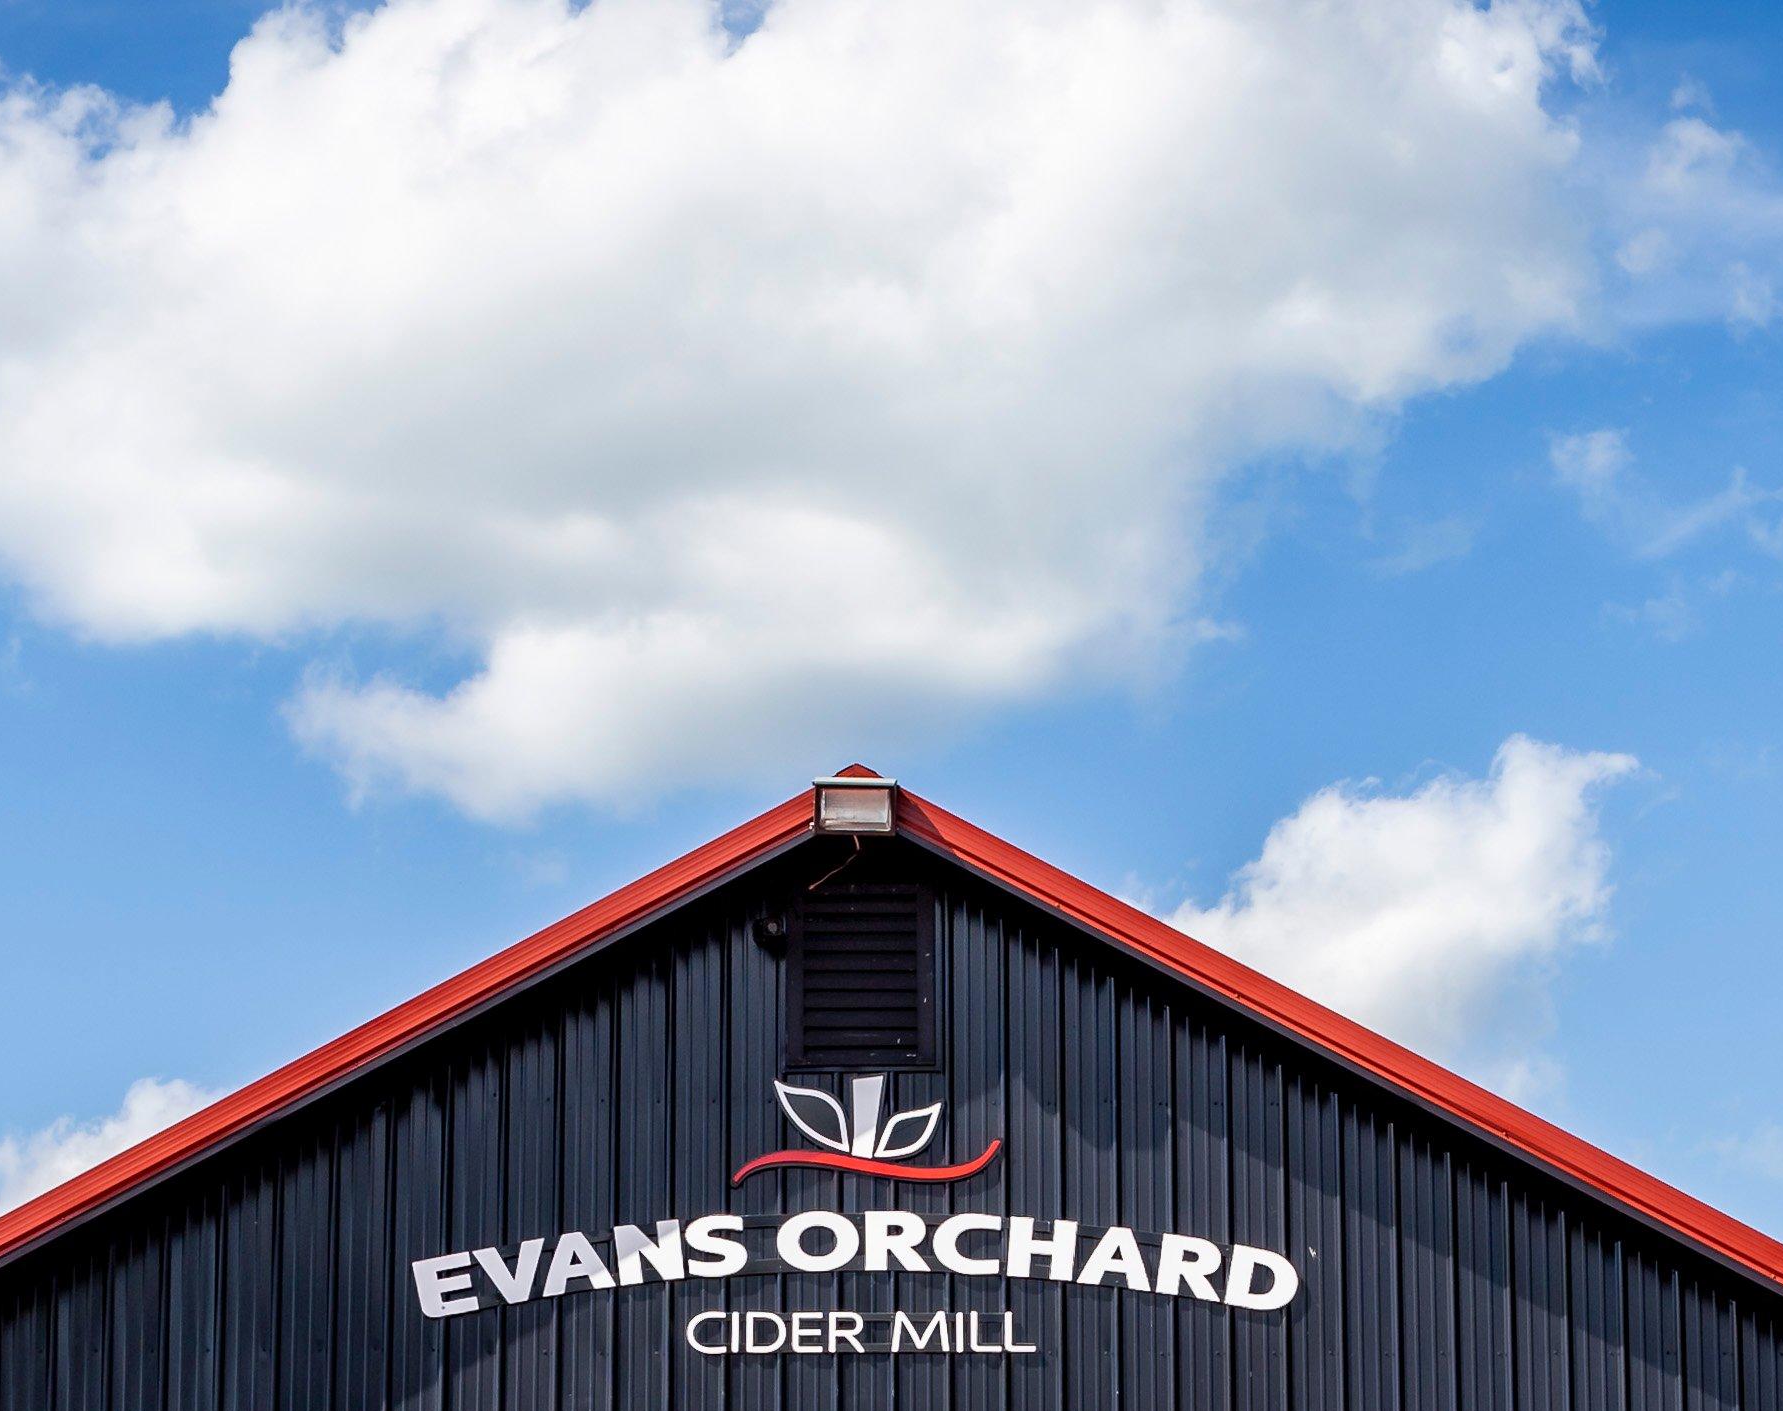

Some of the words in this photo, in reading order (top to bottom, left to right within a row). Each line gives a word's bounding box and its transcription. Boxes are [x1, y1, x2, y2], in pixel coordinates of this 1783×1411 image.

[412, 1213, 746, 1319] EVANS
[775, 1210, 1299, 1311] ORCHARD
[686, 1310, 865, 1356] CIDER
[890, 1310, 1037, 1354] MILL
